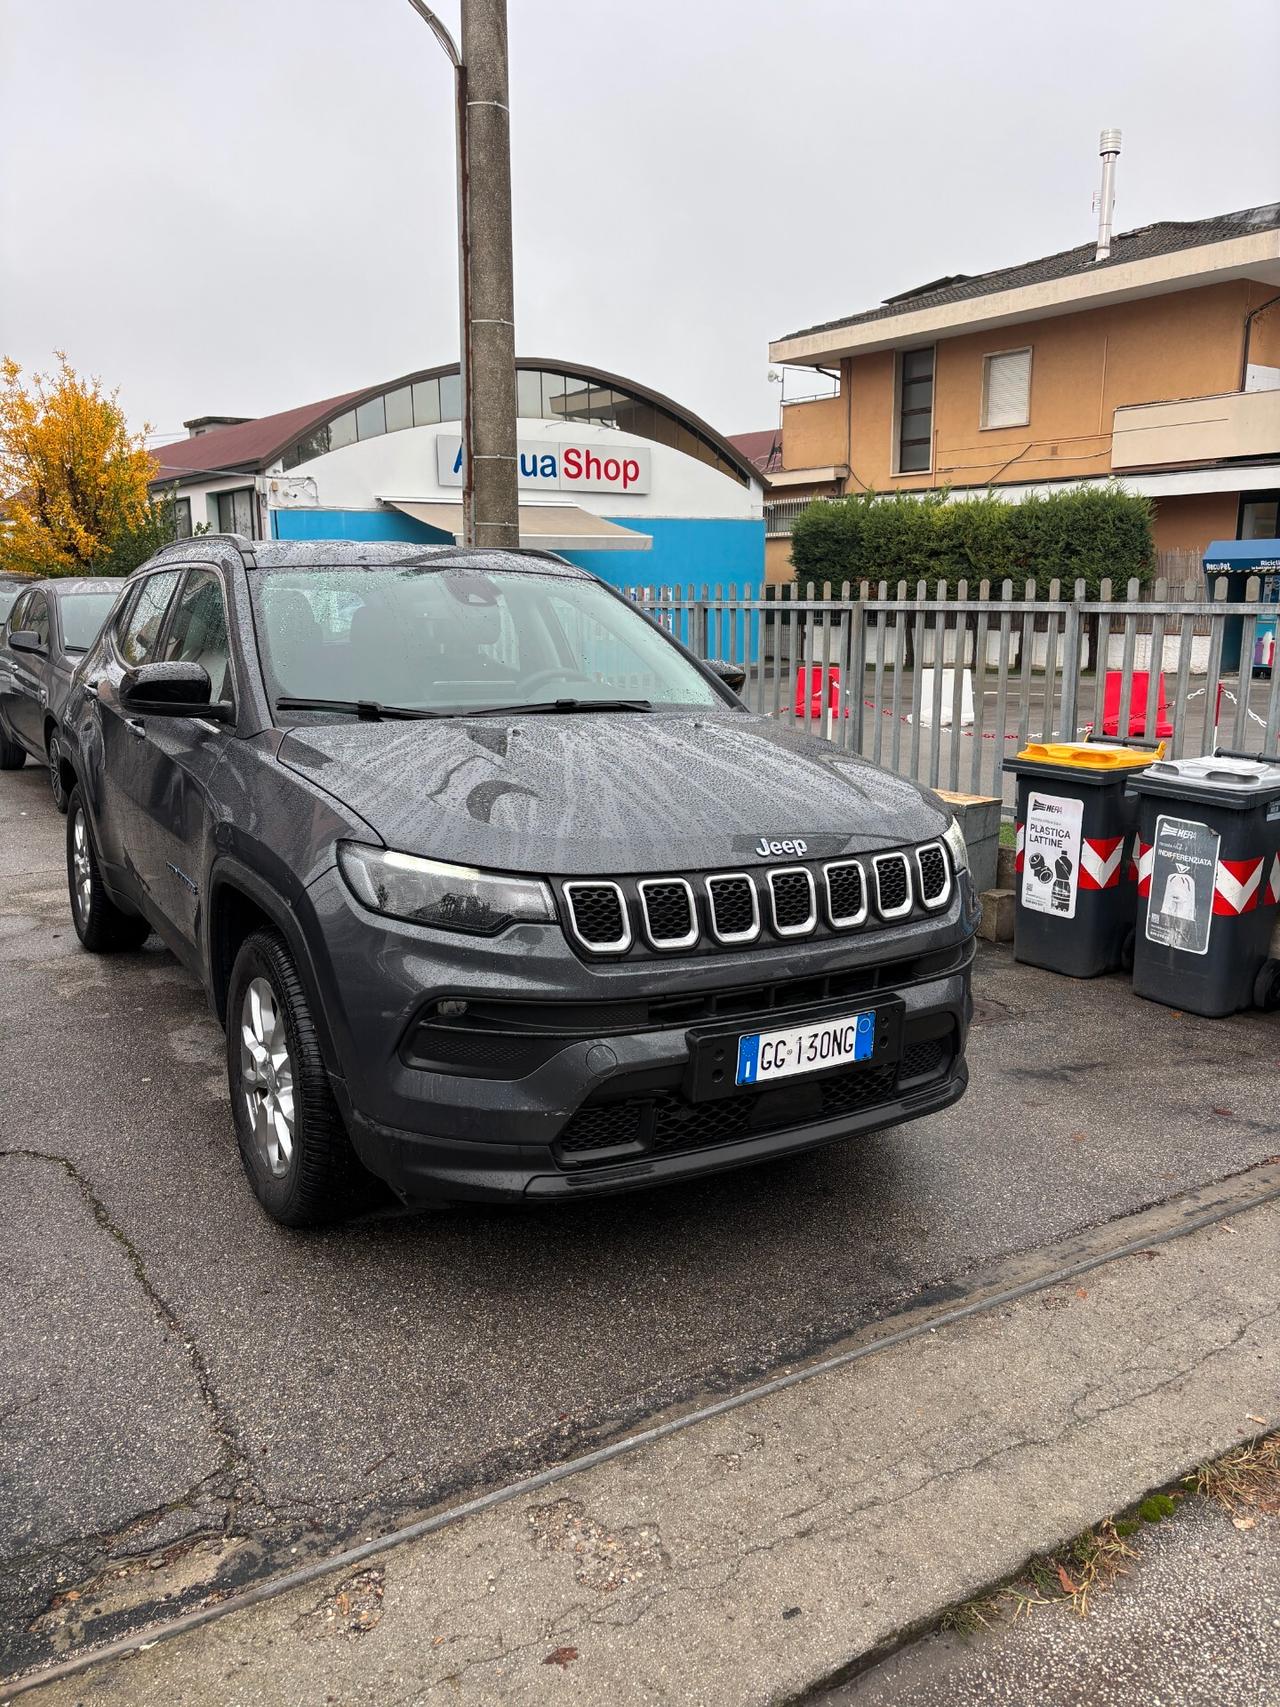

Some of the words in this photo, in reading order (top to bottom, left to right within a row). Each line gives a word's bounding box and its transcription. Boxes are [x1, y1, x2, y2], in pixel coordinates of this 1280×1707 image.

[1030, 823, 1071, 840] PLASTICA
[1177, 828, 1198, 840] HERA
[755, 838, 808, 857] Jeep
[1029, 833, 1063, 849] LATTINE
[1158, 849, 1212, 866] INDIFFERENZIATA
